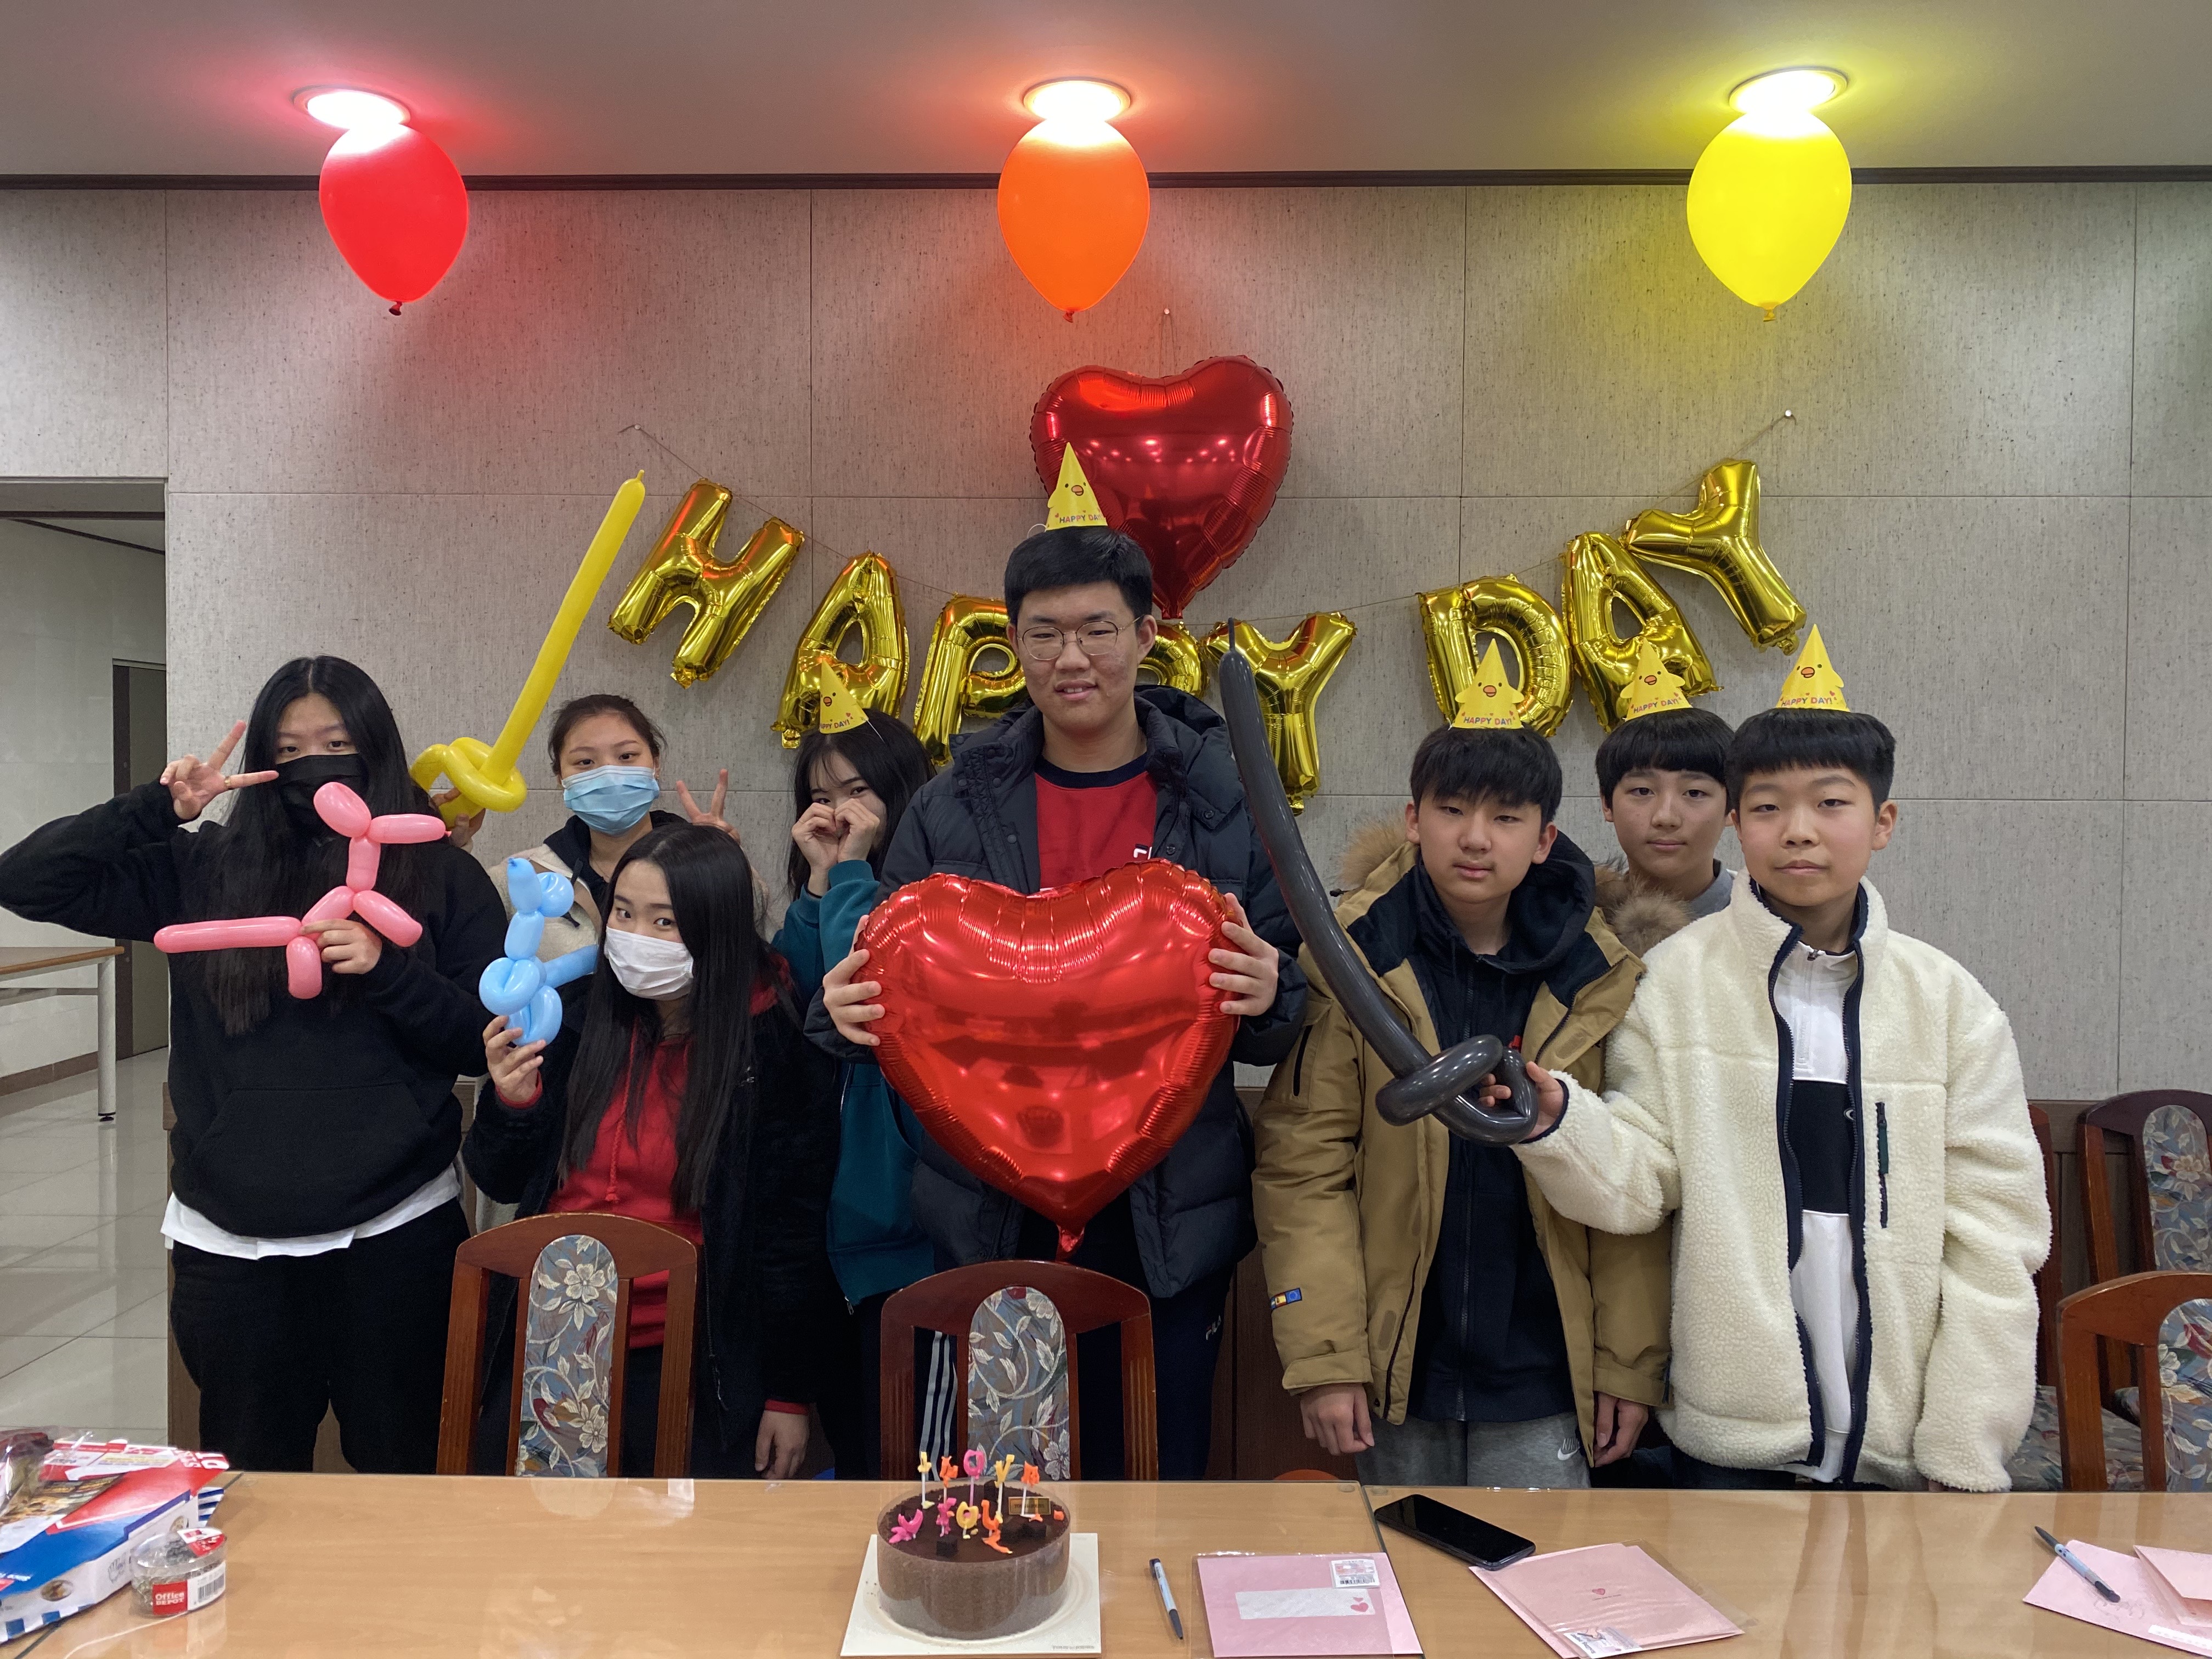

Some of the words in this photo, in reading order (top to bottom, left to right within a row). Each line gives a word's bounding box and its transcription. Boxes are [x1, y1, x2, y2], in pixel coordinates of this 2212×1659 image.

[1059, 515, 1086, 523] HAPPY
[1417, 458, 1808, 737] DAY
[1781, 697, 1808, 707] HAPPY
[1634, 702, 1658, 713] HAPPY
[834, 719, 850, 728] DAY!
[1464, 716, 1492, 725] HAPPY
[1494, 717, 1512, 725] DAY!
[156, 1598, 184, 1606] DEPOT
